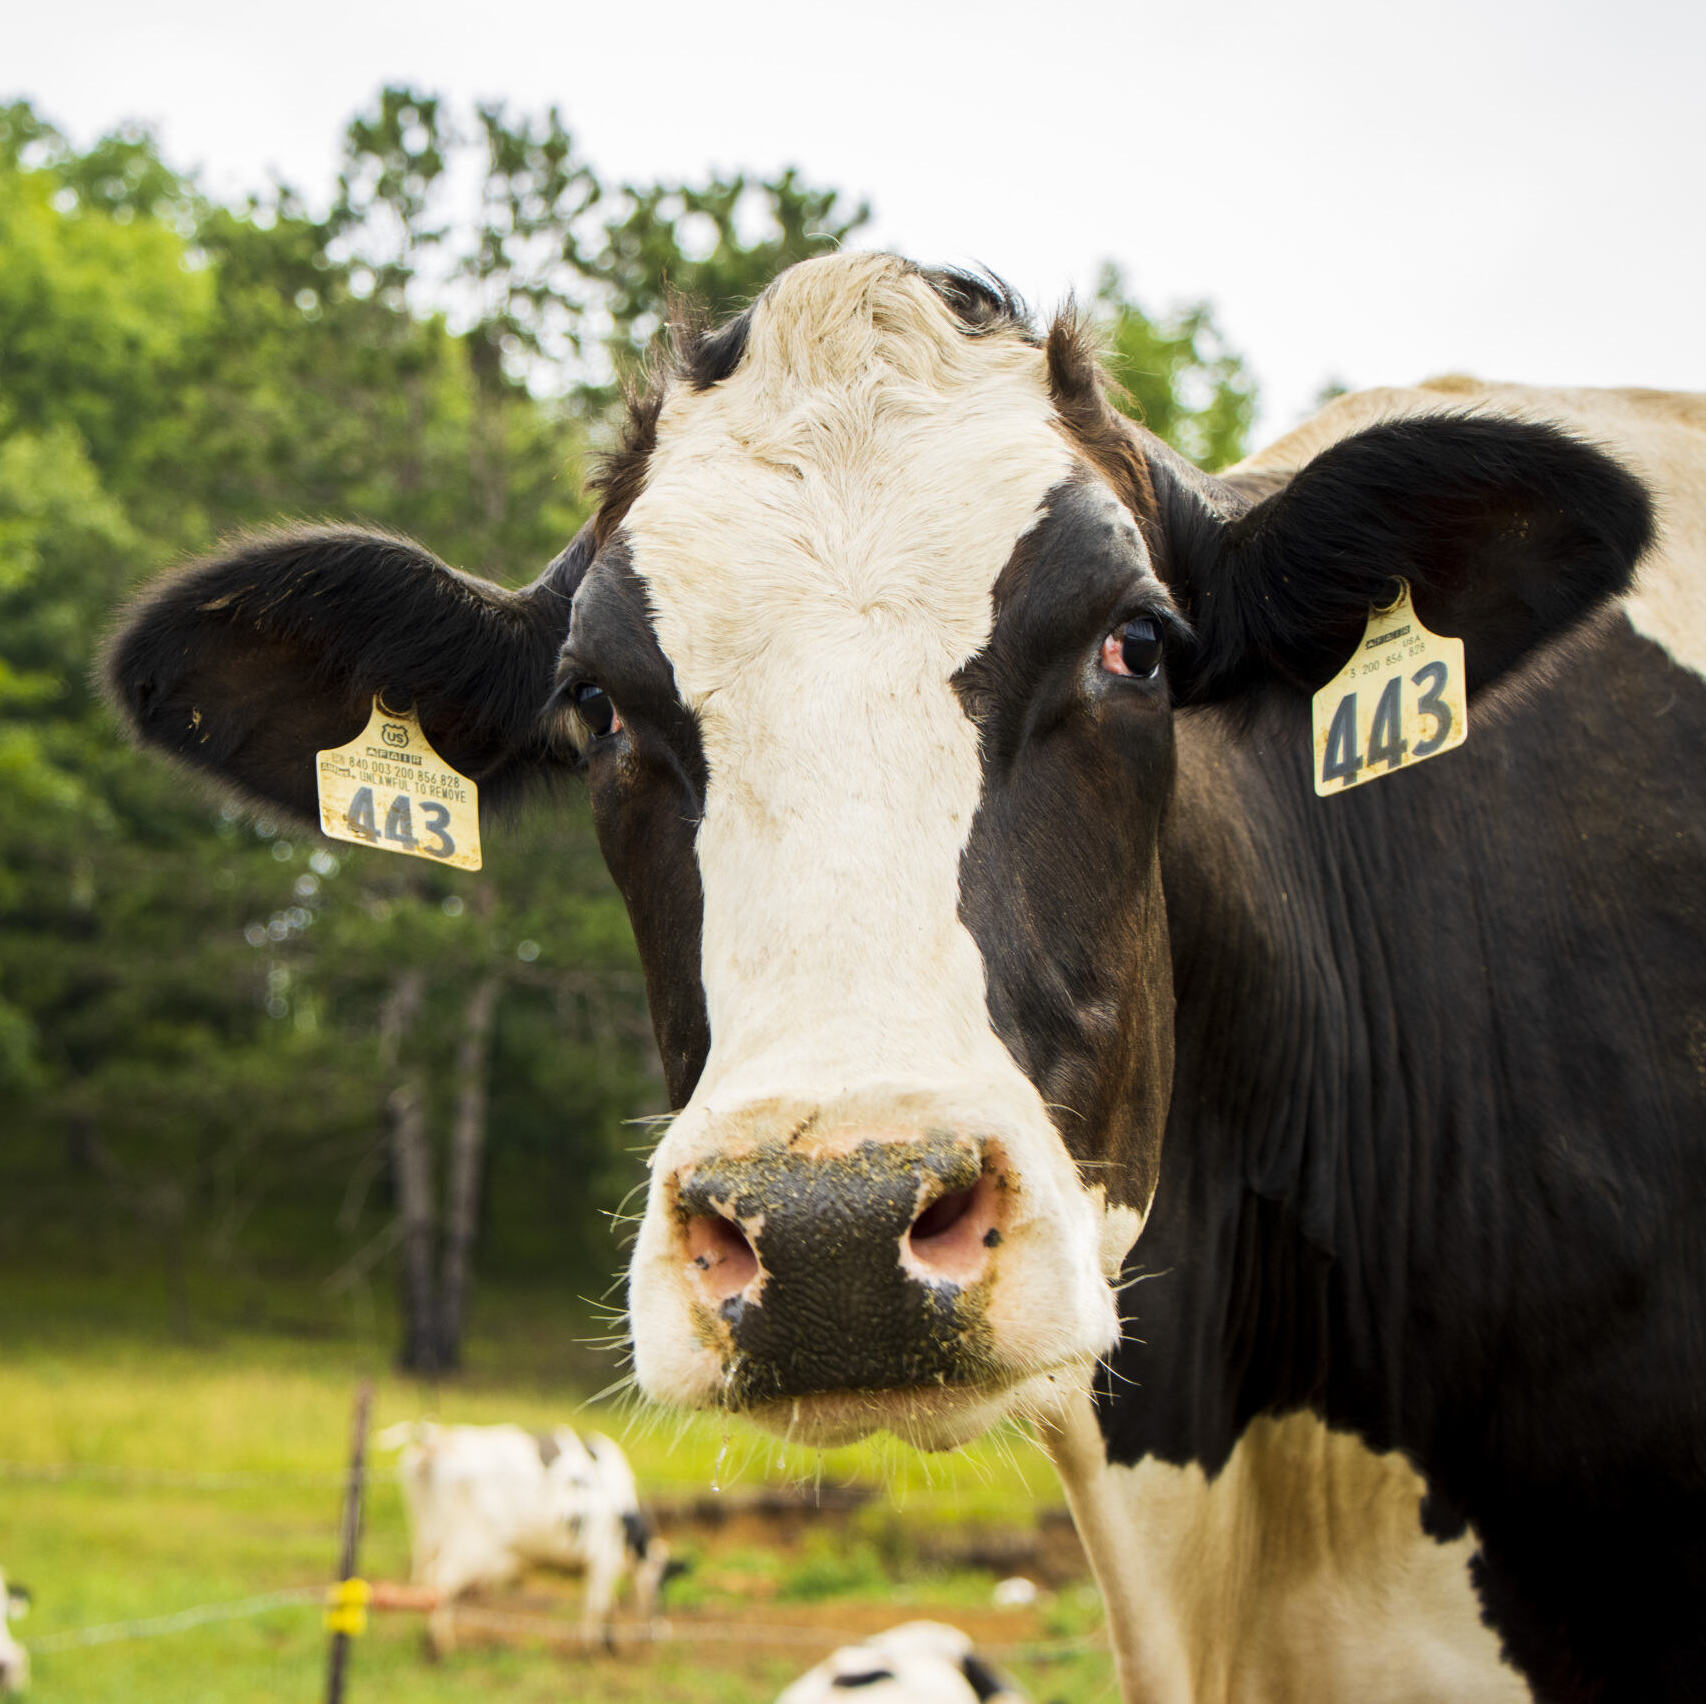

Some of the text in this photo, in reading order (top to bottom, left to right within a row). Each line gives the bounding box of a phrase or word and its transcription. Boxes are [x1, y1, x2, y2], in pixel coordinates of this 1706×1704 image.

[1361, 661, 1380, 675] 200
[387, 731, 404, 743] US
[1322, 660, 1451, 787] 443
[349, 756, 368, 770] 840
[371, 761, 391, 775] 003
[395, 766, 414, 780] 200
[418, 771, 437, 785] 856
[440, 774, 460, 789] 828
[360, 772, 467, 803] UNLAWFUL TO REMOVE
[347, 786, 456, 858] 443
